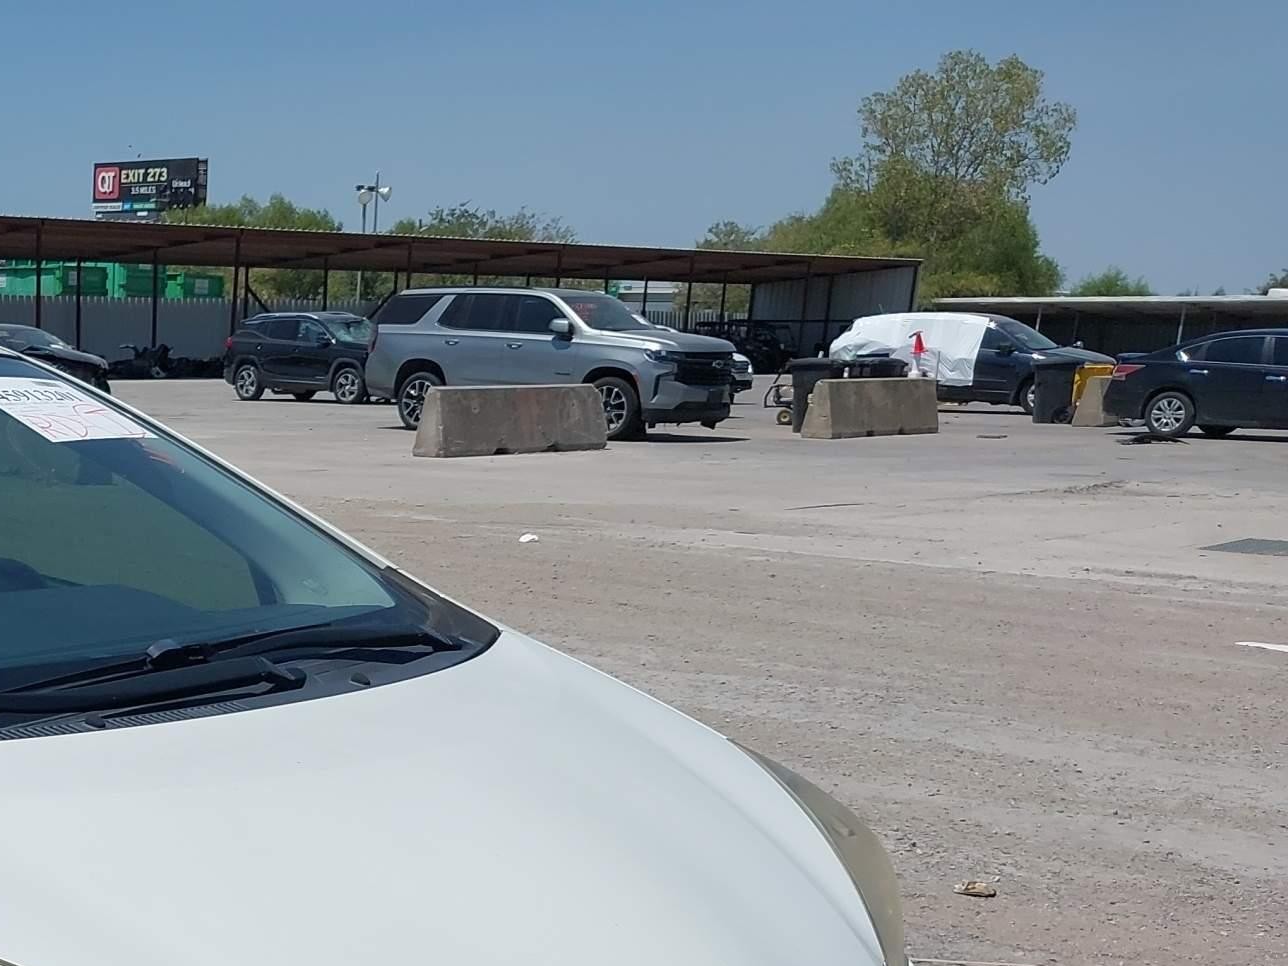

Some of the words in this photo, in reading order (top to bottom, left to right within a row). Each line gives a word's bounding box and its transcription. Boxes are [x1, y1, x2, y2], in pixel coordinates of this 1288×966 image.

[98, 171, 116, 194] QT
[120, 169, 145, 184] EXIT
[147, 167, 168, 182] 273
